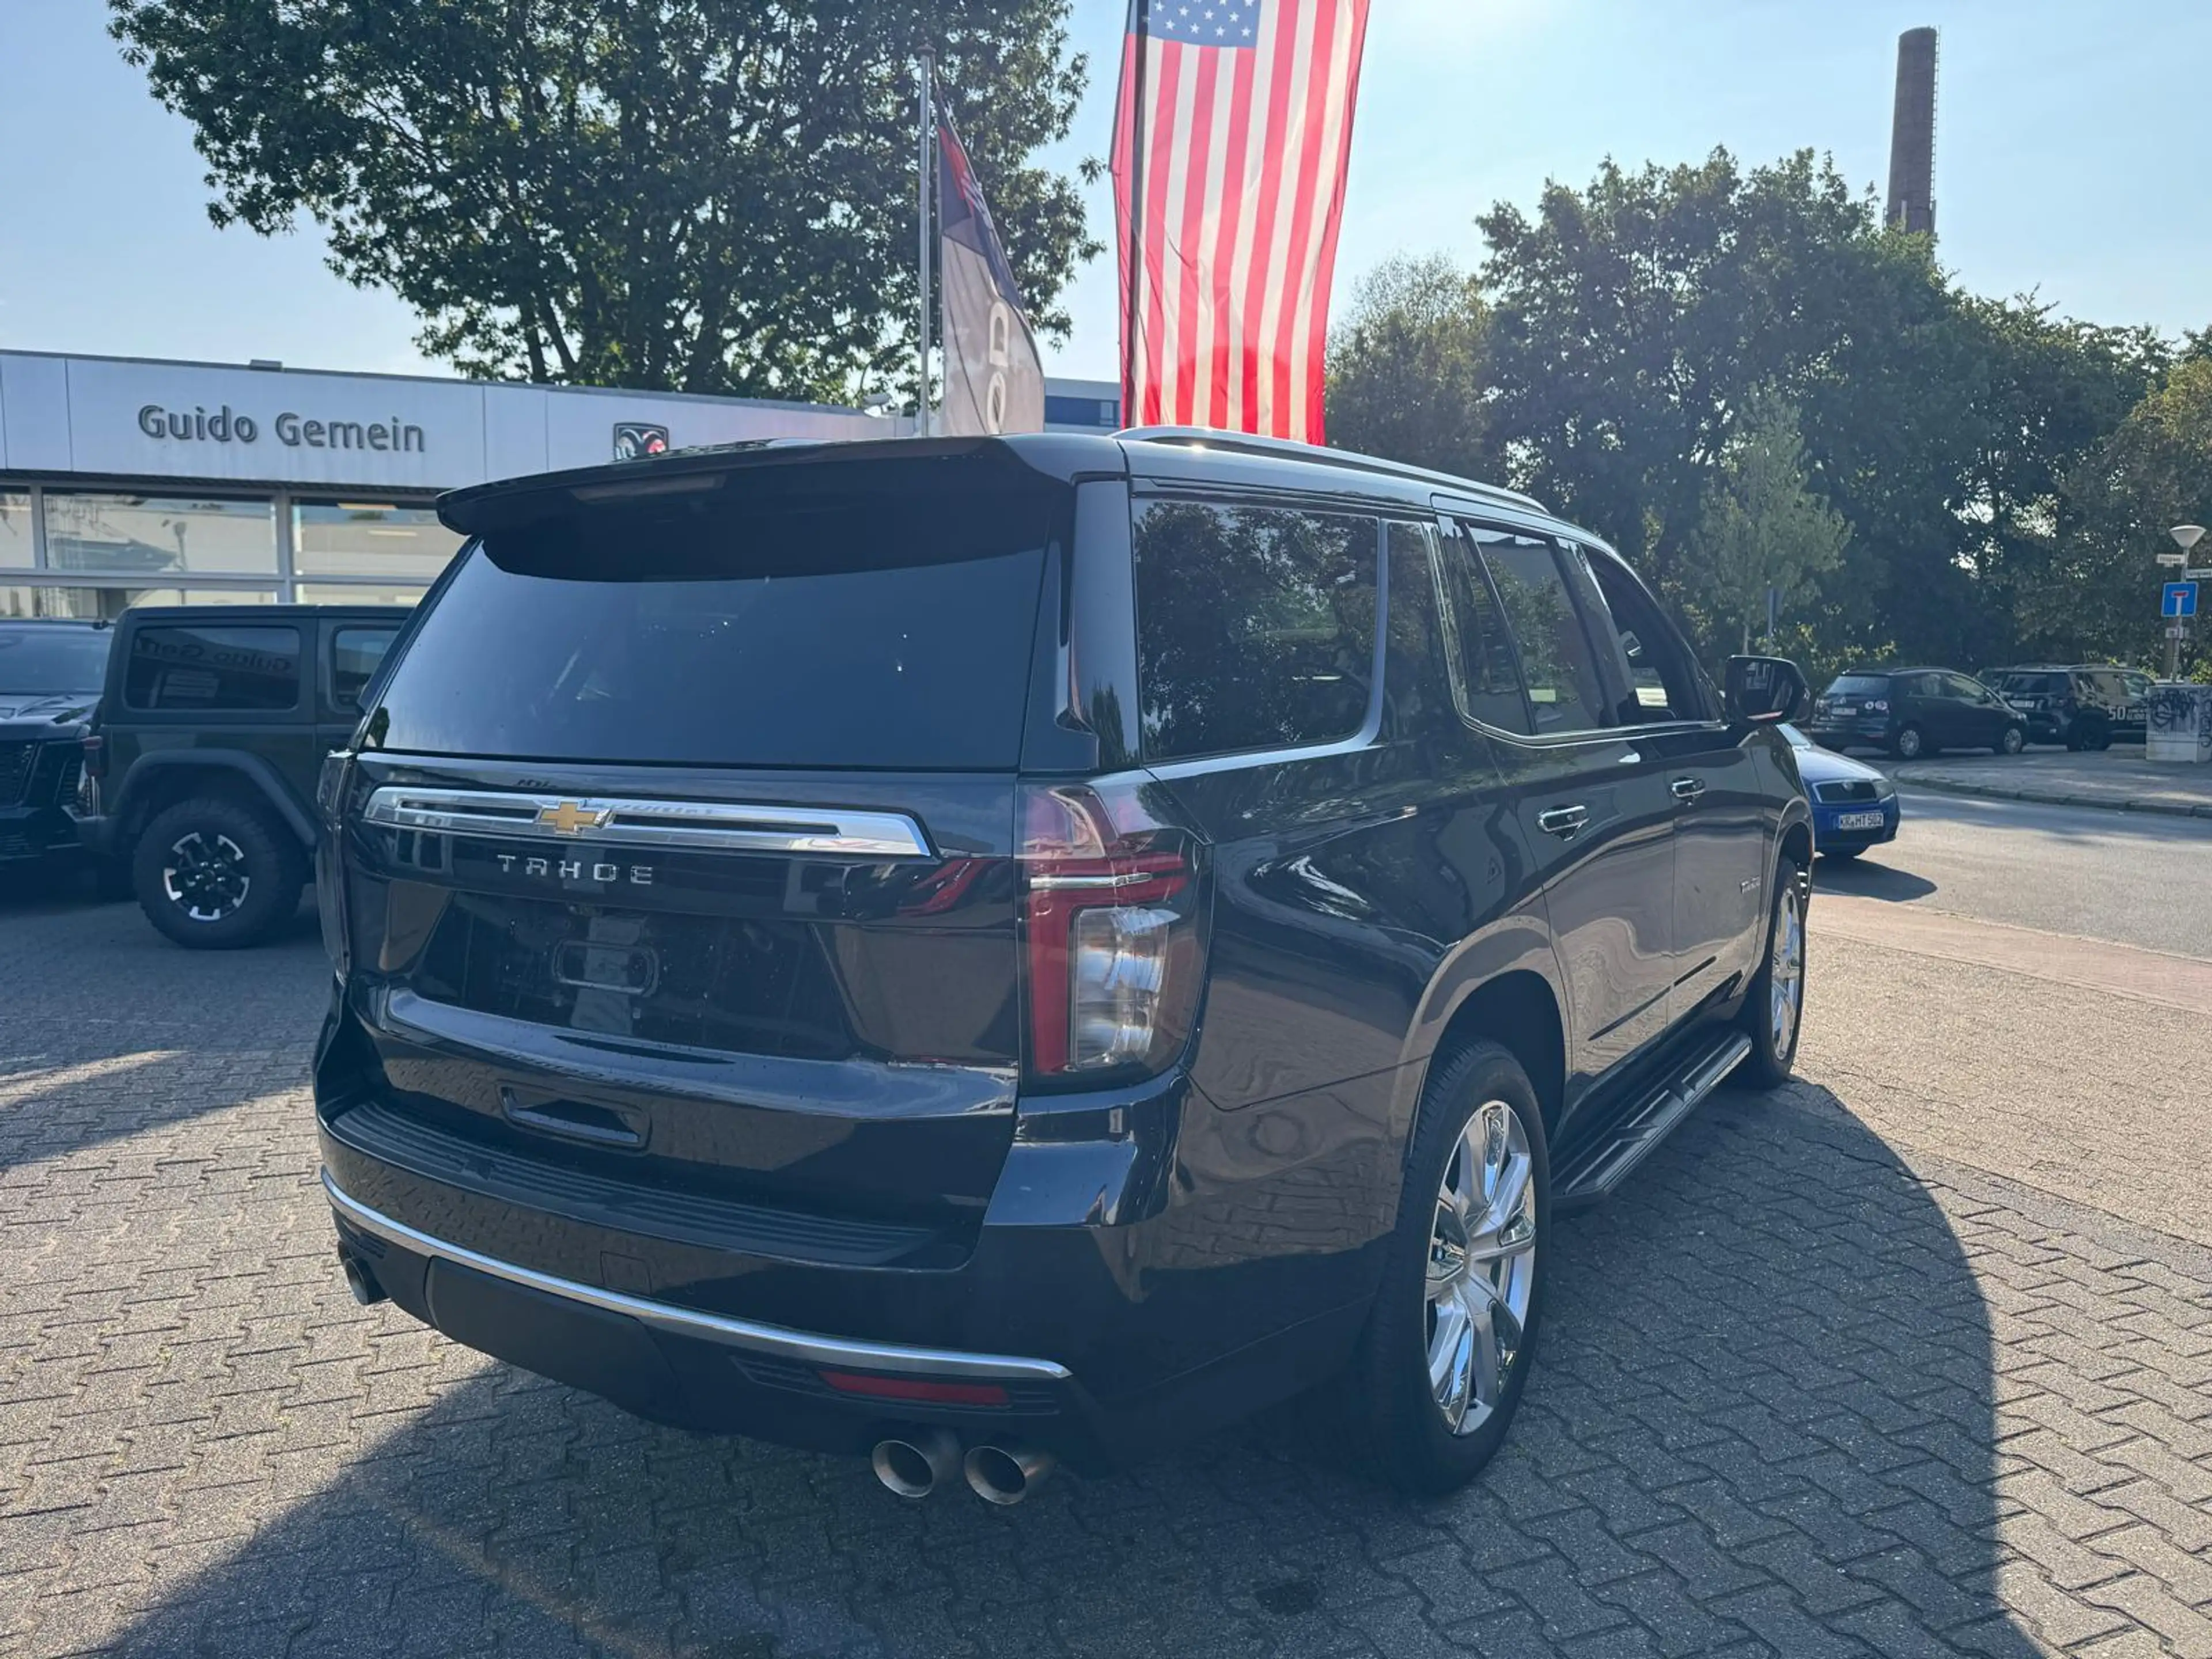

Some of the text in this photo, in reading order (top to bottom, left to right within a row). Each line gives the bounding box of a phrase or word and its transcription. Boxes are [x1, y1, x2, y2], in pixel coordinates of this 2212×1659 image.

[138, 404, 425, 452] Guido Gemein
[497, 854, 653, 885] TAHOE
